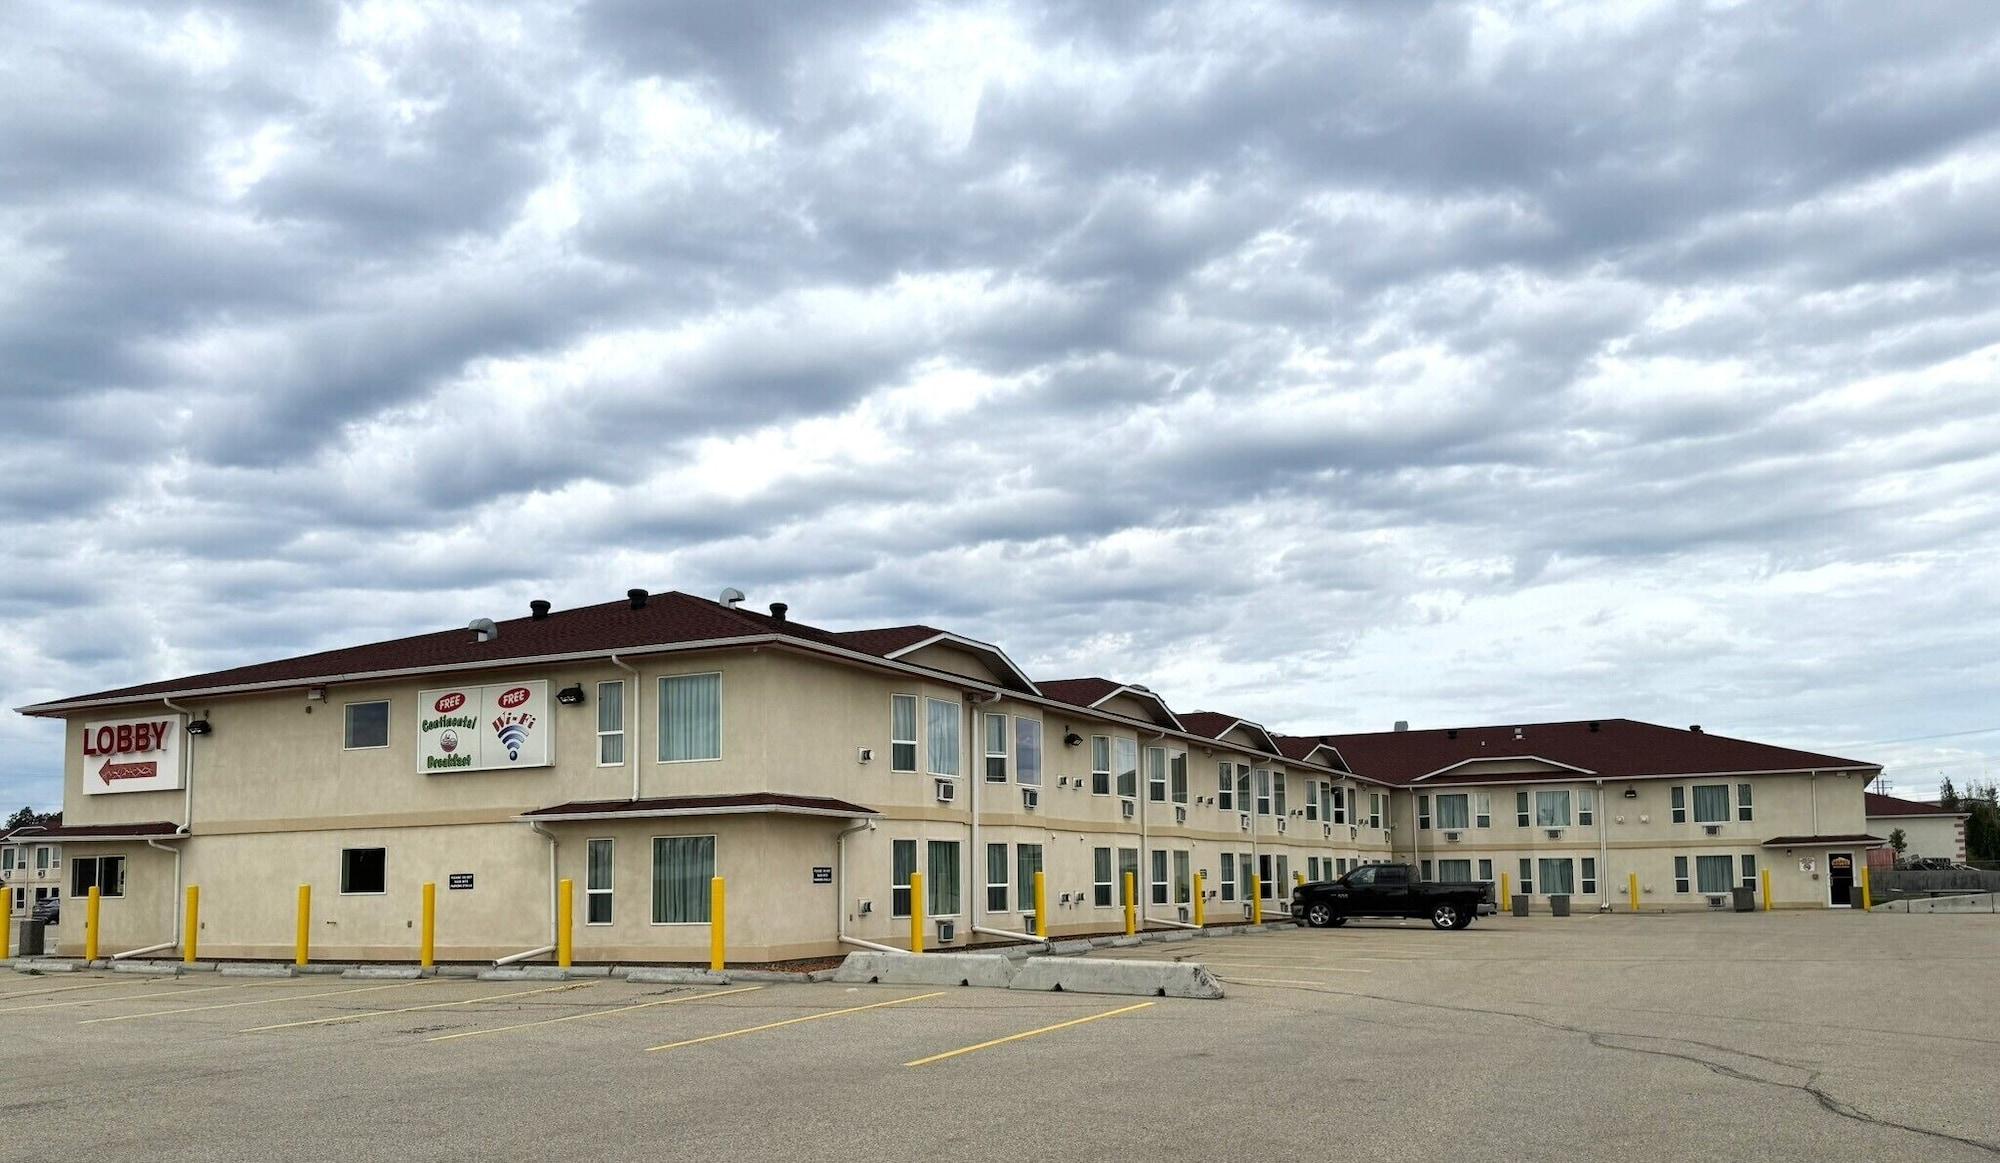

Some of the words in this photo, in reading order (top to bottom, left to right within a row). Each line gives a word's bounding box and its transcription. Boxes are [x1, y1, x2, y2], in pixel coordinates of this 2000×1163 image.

[439, 695, 461, 711] FREE
[503, 690, 526, 706] FREE
[422, 714, 477, 733] Continental
[492, 711, 536, 733] Wi-Fi
[83, 721, 168, 755] LOBBY
[427, 753, 472, 769] Breakfast
